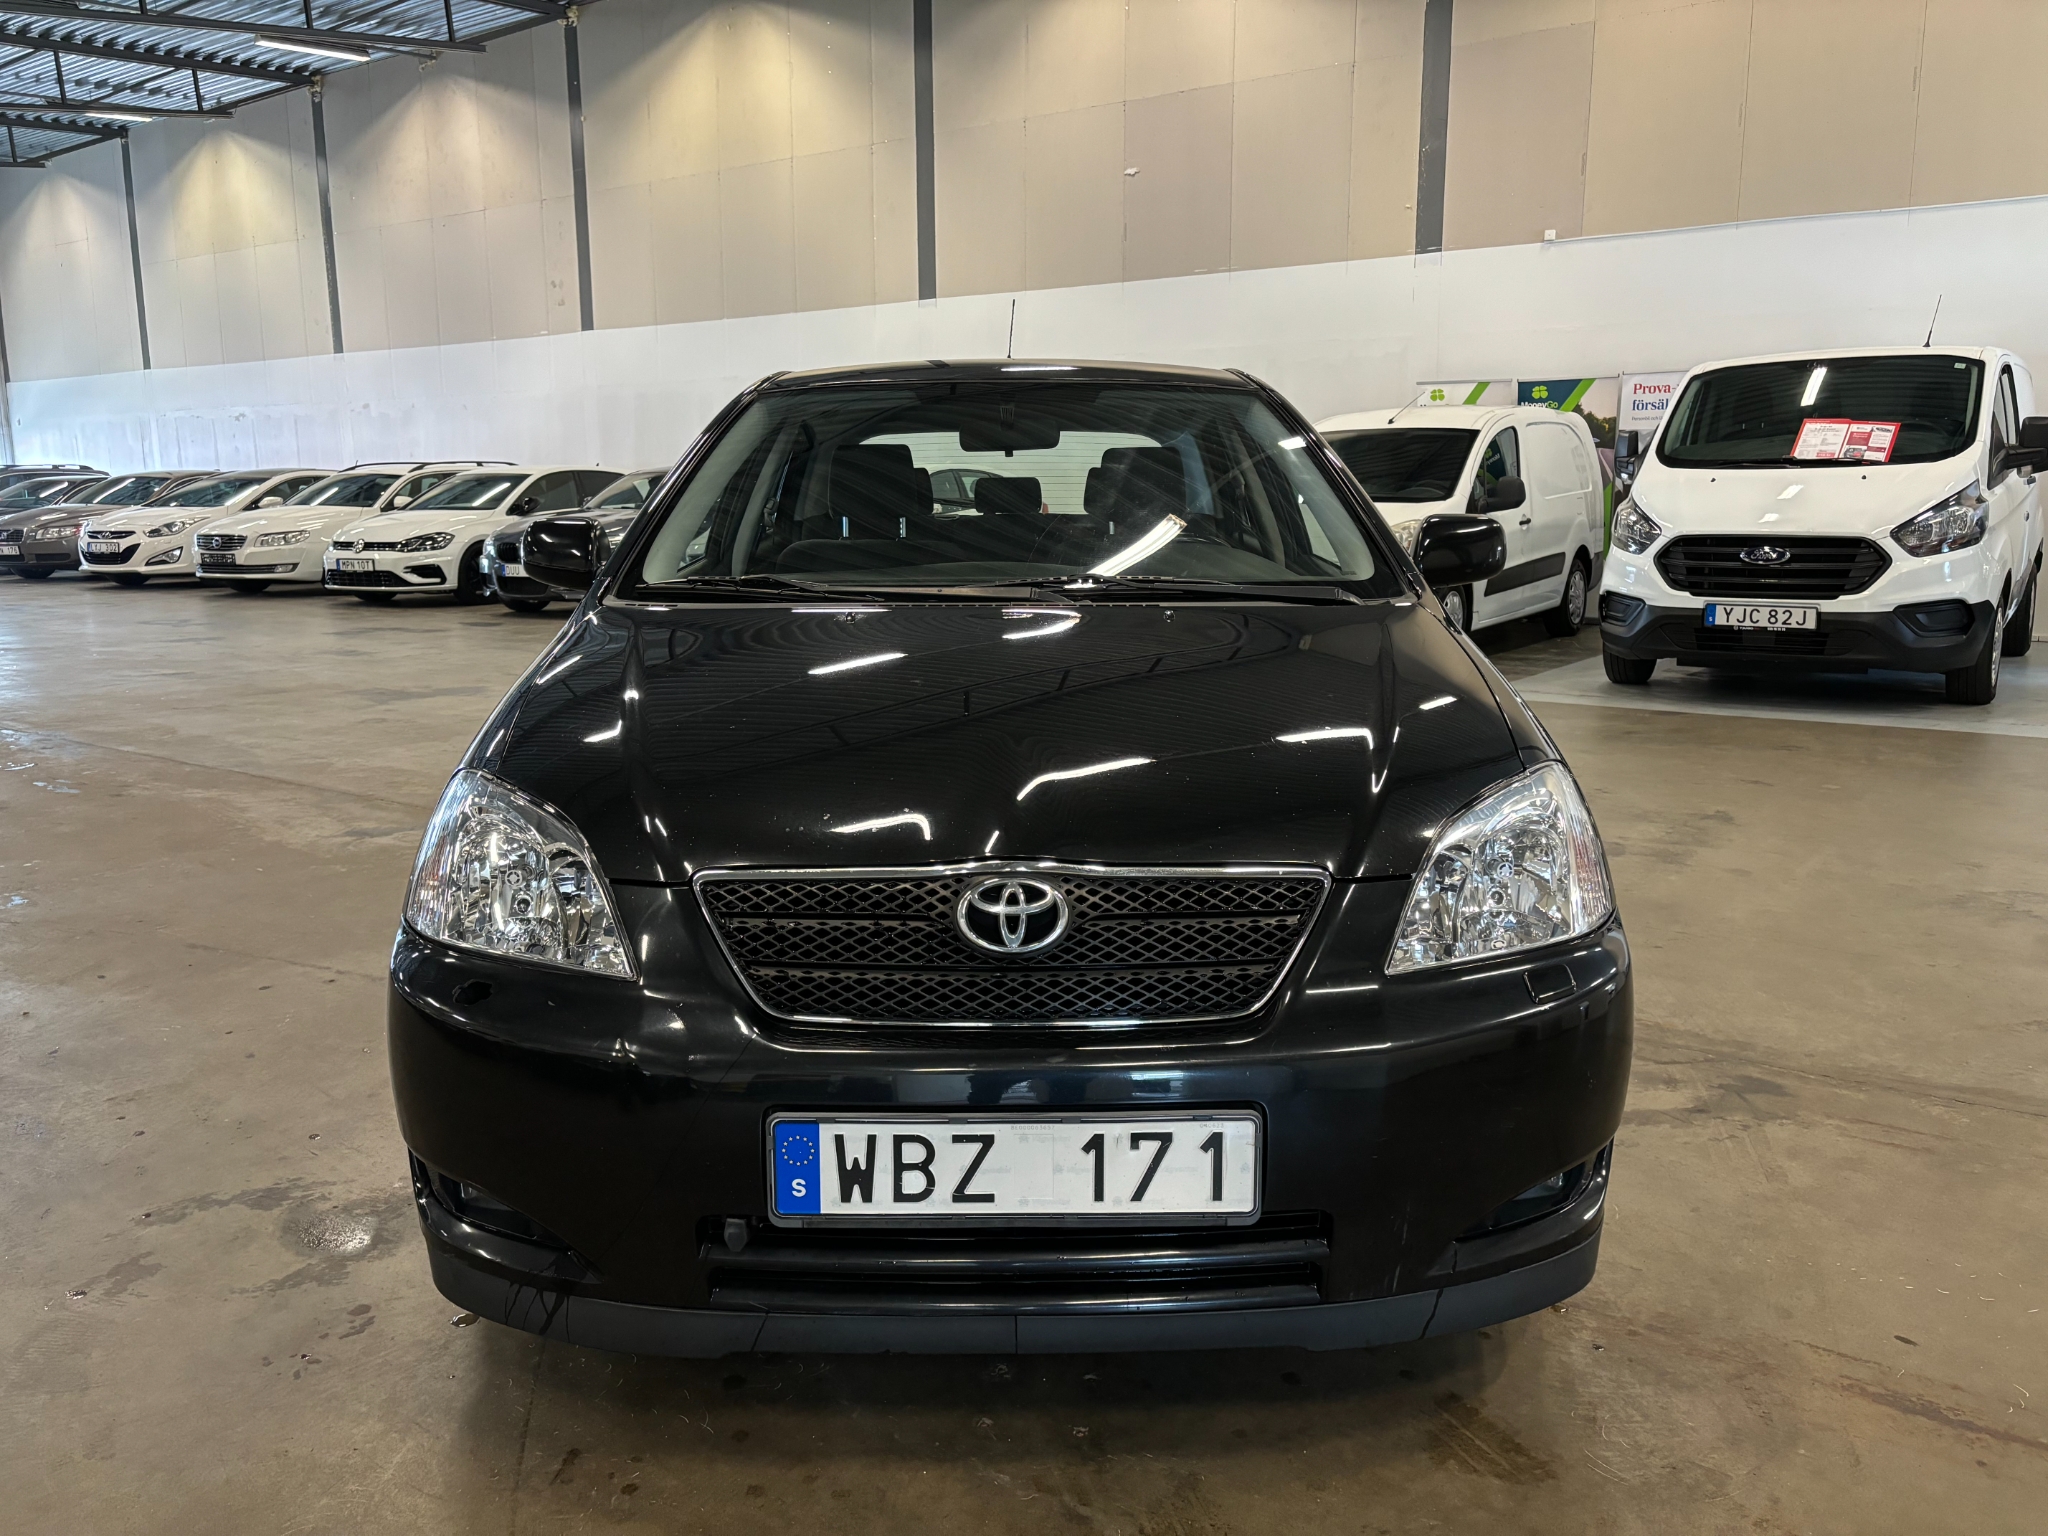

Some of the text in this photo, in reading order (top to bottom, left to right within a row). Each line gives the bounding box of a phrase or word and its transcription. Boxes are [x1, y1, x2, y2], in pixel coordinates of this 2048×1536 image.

[1723, 606, 1807, 626] YJC 82J
[834, 1131, 1224, 1203] WBZ 171
[791, 1178, 807, 1197] S
